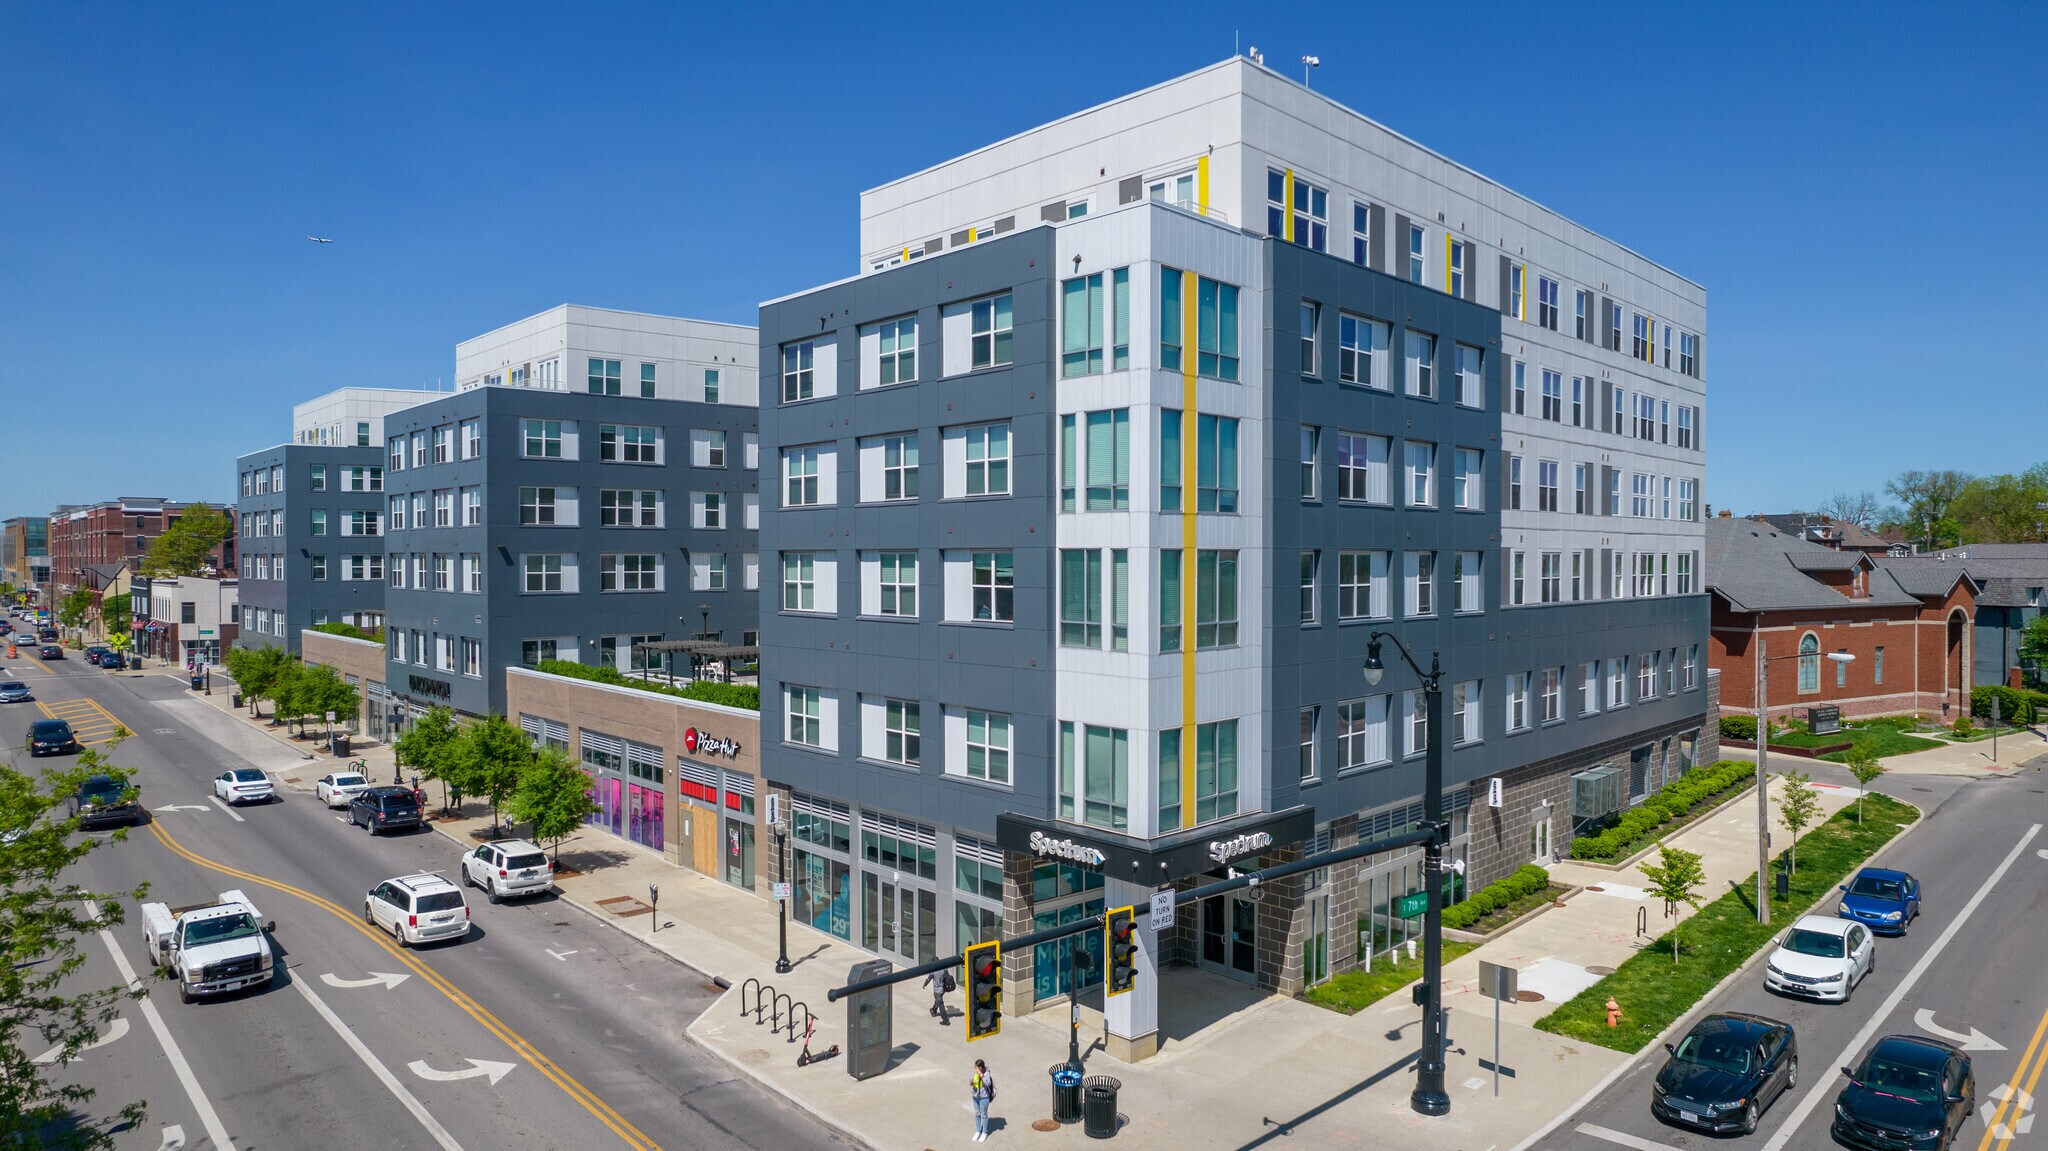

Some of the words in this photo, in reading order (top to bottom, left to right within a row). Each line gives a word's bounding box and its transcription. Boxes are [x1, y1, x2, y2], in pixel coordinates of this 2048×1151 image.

[697, 732, 720, 752] Pizza
[720, 737, 739, 757] Hut
[1030, 831, 1105, 866] Spectrum
[1209, 832, 1273, 864] Spectrum
[1158, 896, 1168, 905] NO
[1407, 900, 1419, 912] 7th
[1155, 905, 1170, 916] TURN
[1152, 918, 1160, 927] ON
[1161, 914, 1172, 926] RED
